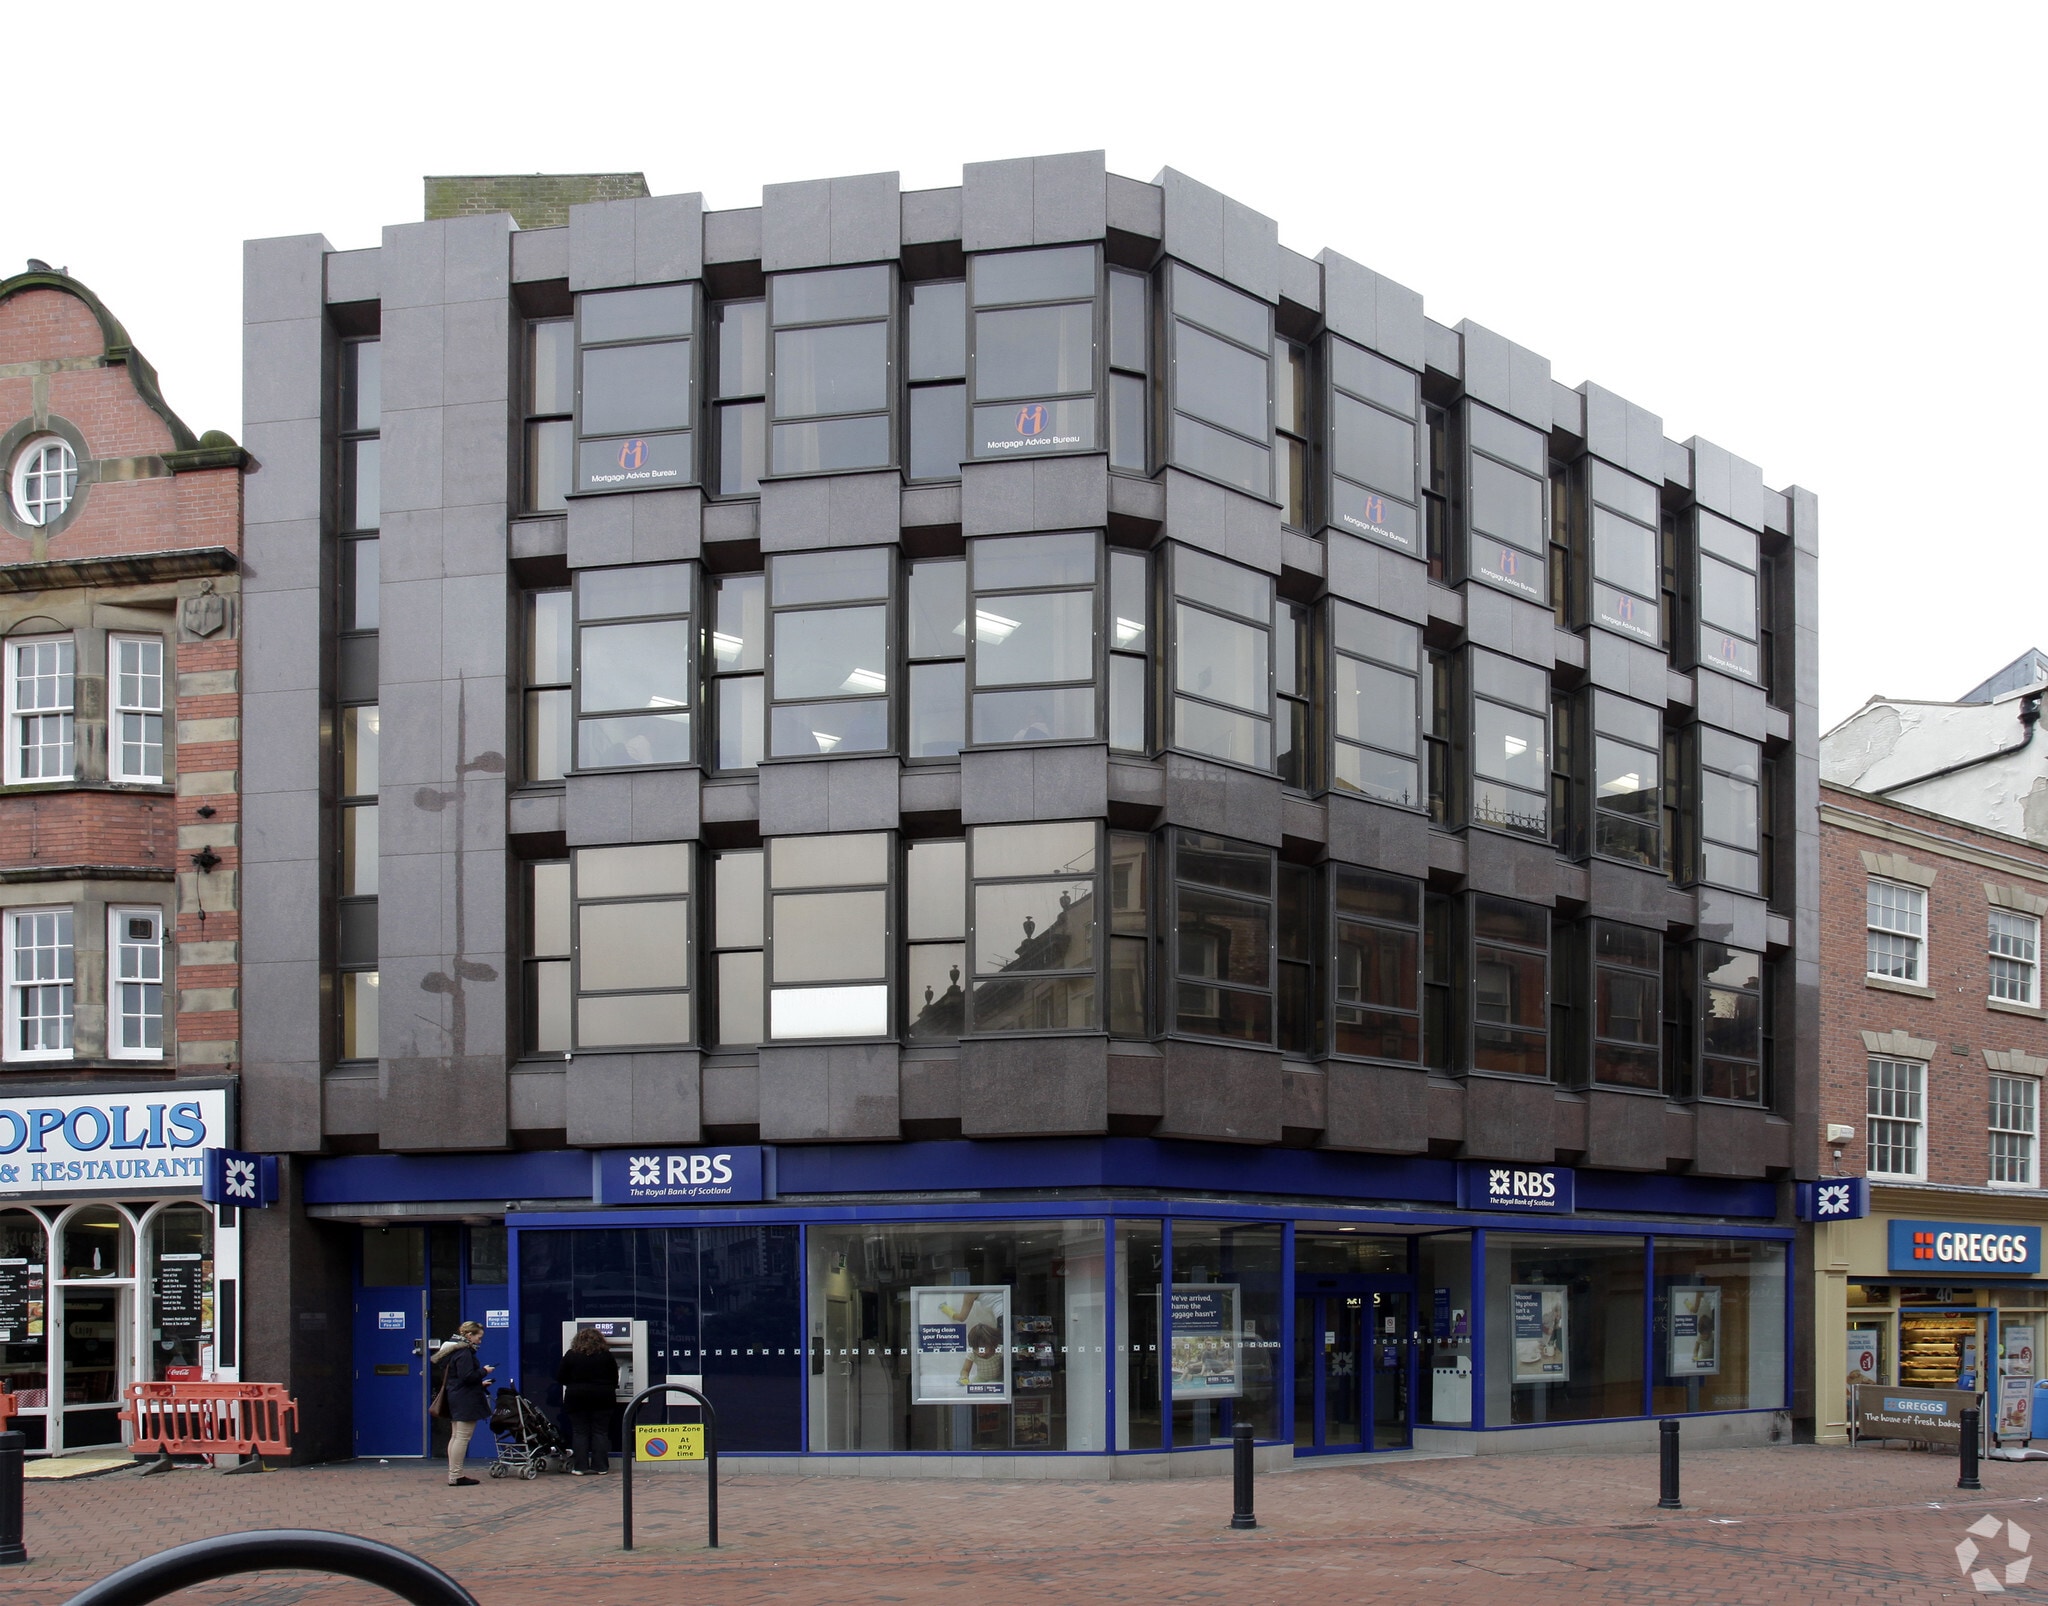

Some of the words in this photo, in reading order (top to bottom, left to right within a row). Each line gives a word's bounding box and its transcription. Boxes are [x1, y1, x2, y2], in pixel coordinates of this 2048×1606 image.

[987, 440, 1024, 449] Mortgage
[1025, 437, 1051, 446] Advice
[1052, 435, 1080, 444] Bureau
[591, 474, 625, 483] Mortgage
[626, 471, 651, 480] Advice
[651, 469, 677, 477] Bureau
[1343, 513, 1370, 530] Mortgage
[1370, 525, 1389, 537] Advice
[1389, 531, 1409, 545] Bureau
[1480, 567, 1504, 582] Mortgage
[0, 1163, 20, 1183] &
[31, 1156, 204, 1182] RESTAURANT
[666, 1154, 732, 1185] RBS
[1513, 1170, 1555, 1198] RBS
[630, 1188, 644, 1197] The
[645, 1187, 667, 1198] Royal
[668, 1186, 687, 1196] Bank
[688, 1186, 698, 1197] of
[698, 1186, 732, 1196] Scotland
[1499, 1197, 1514, 1206] Royal
[1514, 1198, 1527, 1206] Bank
[1527, 1199, 1534, 1207] of
[1936, 1231, 2028, 1263] GREGGS
[1188, 1294, 1212, 1302] arrived,
[1936, 1287, 1953, 1303] 40
[1898, 1400, 1944, 1413] GREGGS
[1864, 1412, 1880, 1422] The
[1880, 1413, 1901, 1424] home
[1902, 1415, 1912, 1424] of
[1913, 1415, 1936, 1427] fresh
